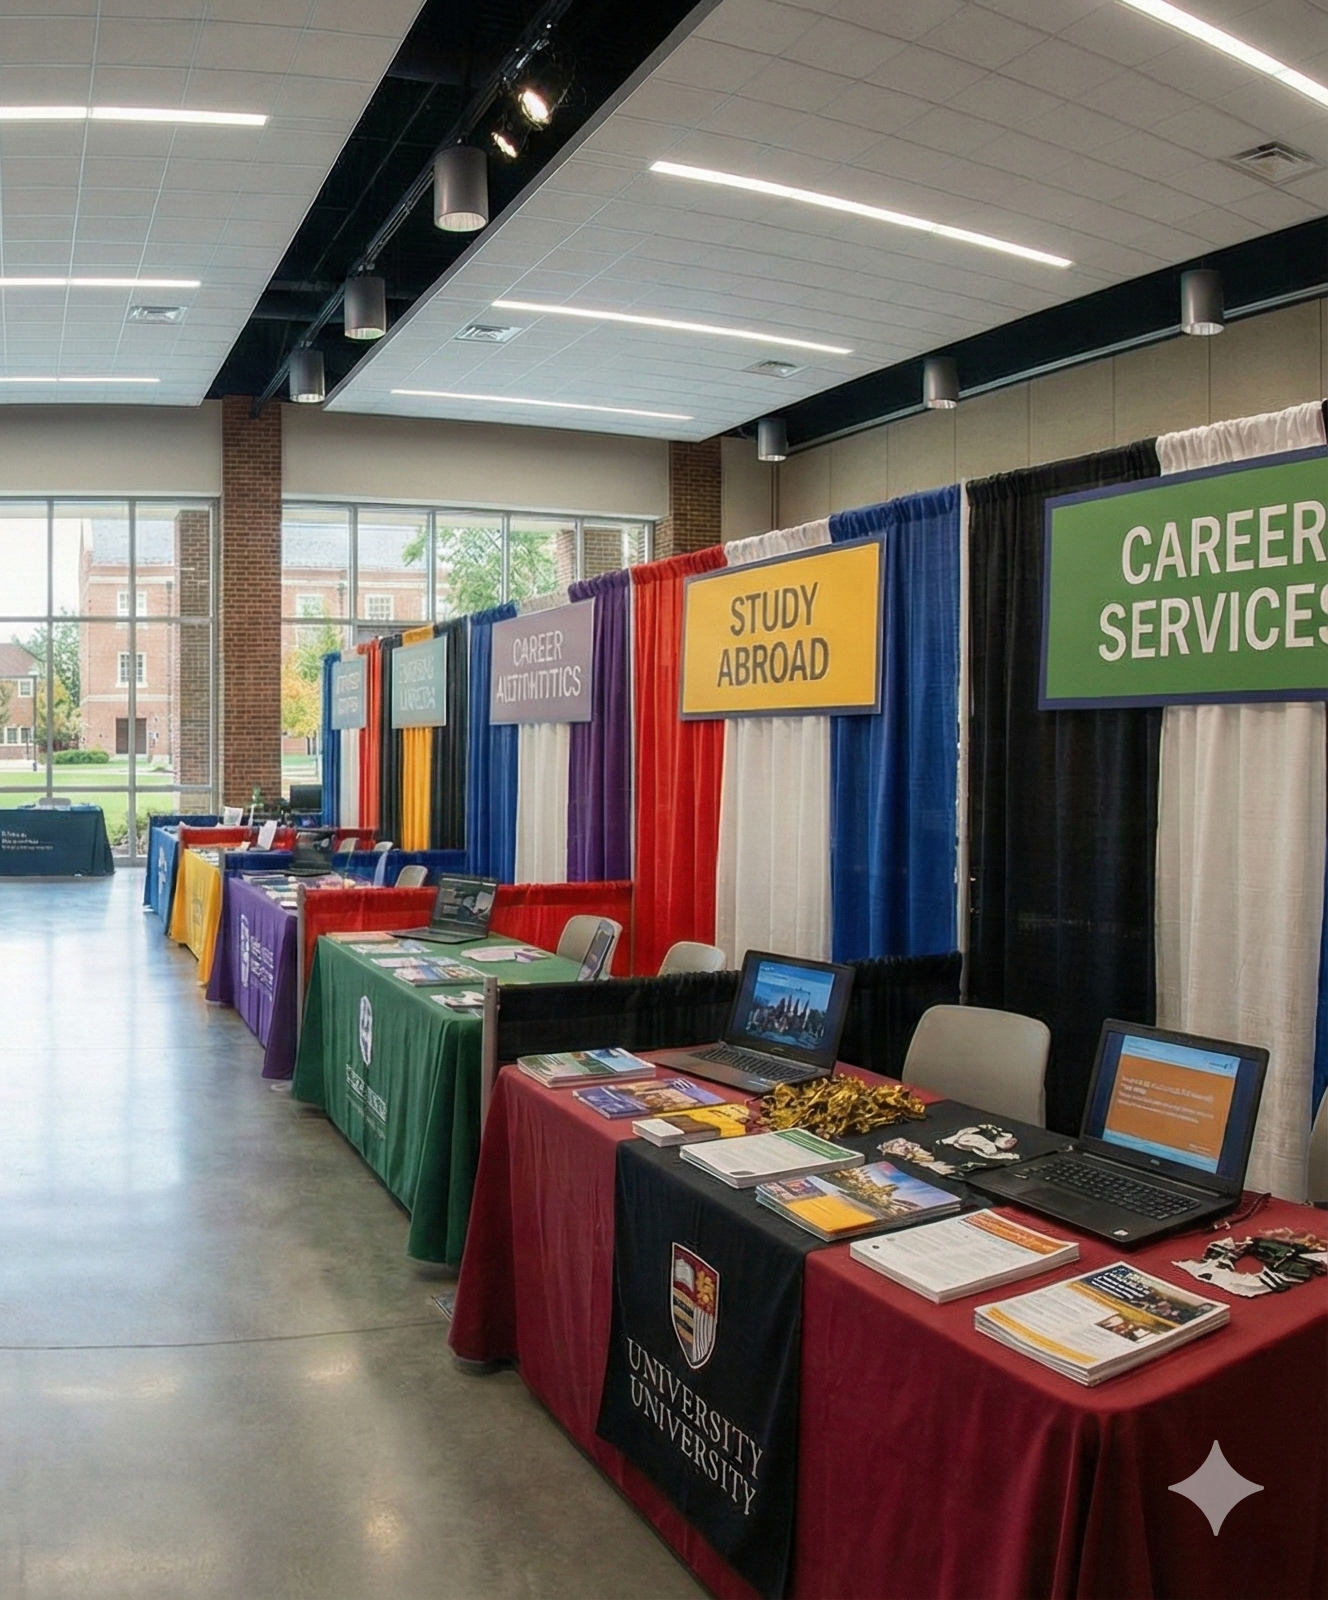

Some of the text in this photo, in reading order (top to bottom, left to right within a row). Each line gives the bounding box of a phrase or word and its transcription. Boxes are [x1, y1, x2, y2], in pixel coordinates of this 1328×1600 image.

[1121, 500, 1327, 585] CAREER
[730, 582, 818, 636] STUDY
[513, 630, 563, 667] CAREER
[717, 637, 829, 688] ABROAD
[627, 1338, 763, 1480] UNIVERSITY
[630, 1373, 756, 1516] UNIVERSITY
